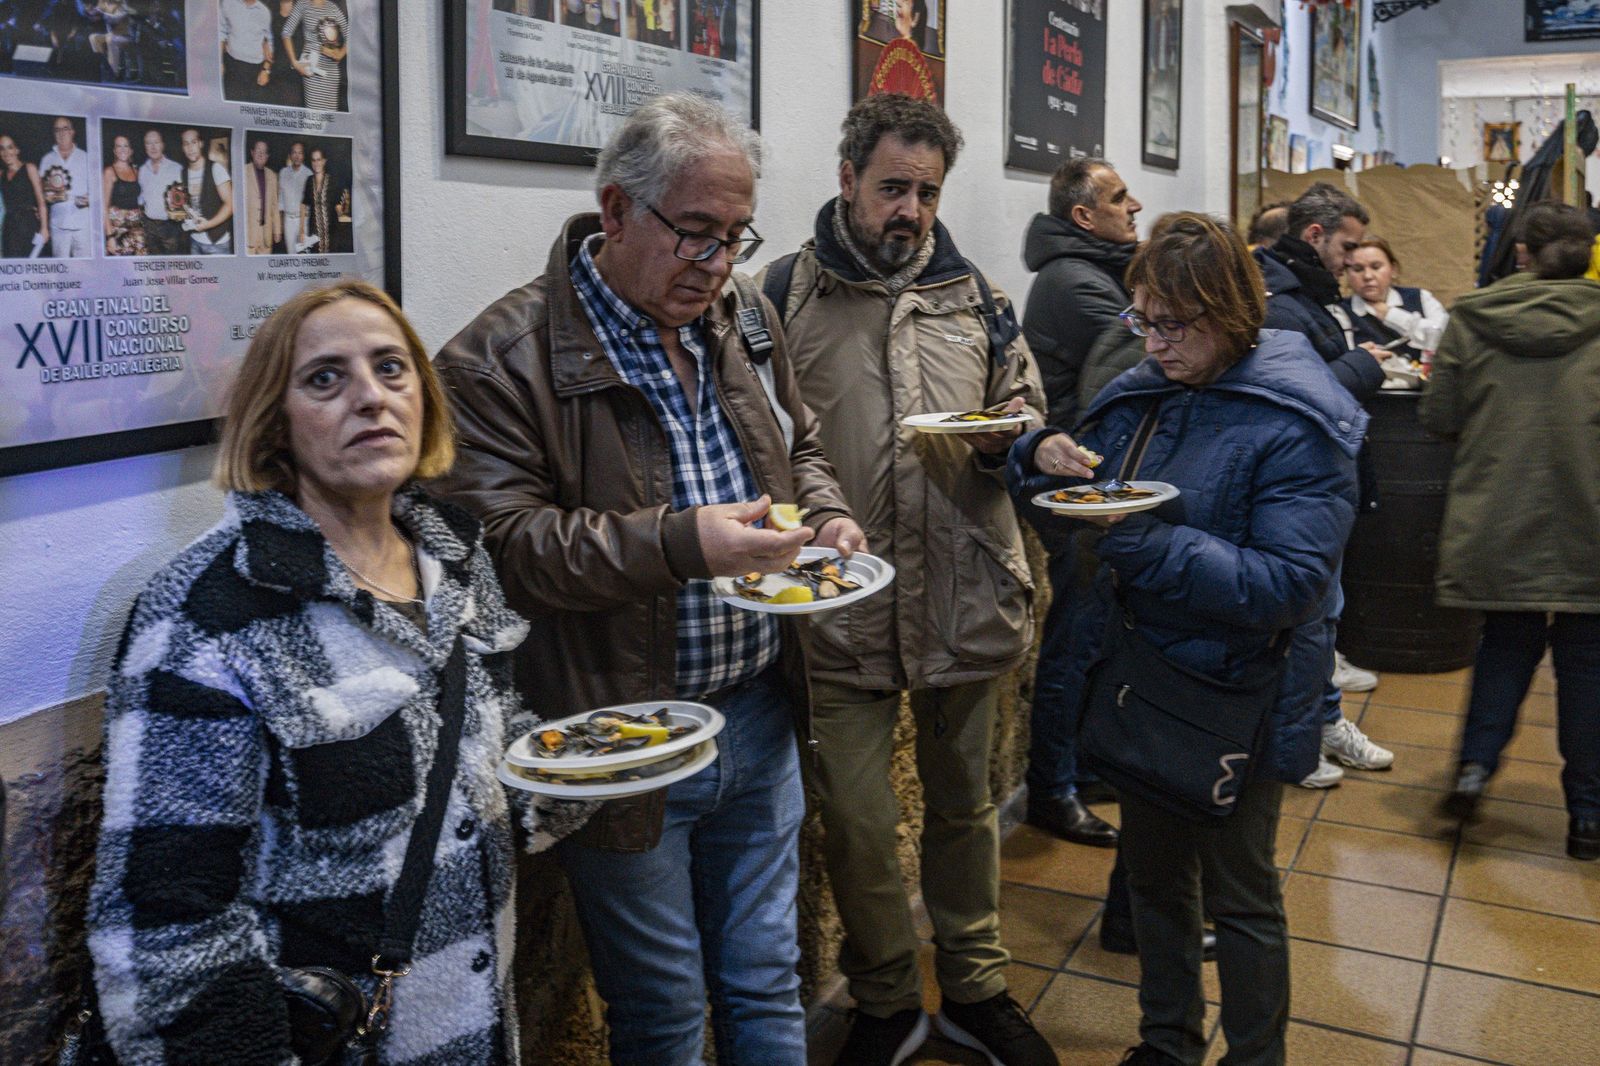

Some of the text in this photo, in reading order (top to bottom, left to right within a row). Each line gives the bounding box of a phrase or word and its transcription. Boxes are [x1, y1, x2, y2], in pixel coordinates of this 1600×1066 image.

[1043, 27, 1082, 67] La Perla
[584, 71, 626, 105] XVIII
[1043, 59, 1082, 96] de Cádiz
[240, 106, 267, 116] PRIMER
[269, 108, 297, 119] PREMIO
[25, 263, 69, 274] PREMIO:
[133, 260, 203, 272] TERCER PREMIO:
[268, 258, 300, 268] CUARTO
[123, 278, 143, 287] Juan
[165, 276, 186, 285] Villar
[43, 295, 171, 319] GRAN FINAL DEL
[105, 316, 190, 337] CONCURSO
[230, 325, 245, 340] EL
[15, 318, 103, 369] XVII
[107, 335, 185, 357] NACIONAL
[40, 368, 61, 384] DE
[62, 363, 102, 382] BAILE
[102, 361, 130, 377] POR
